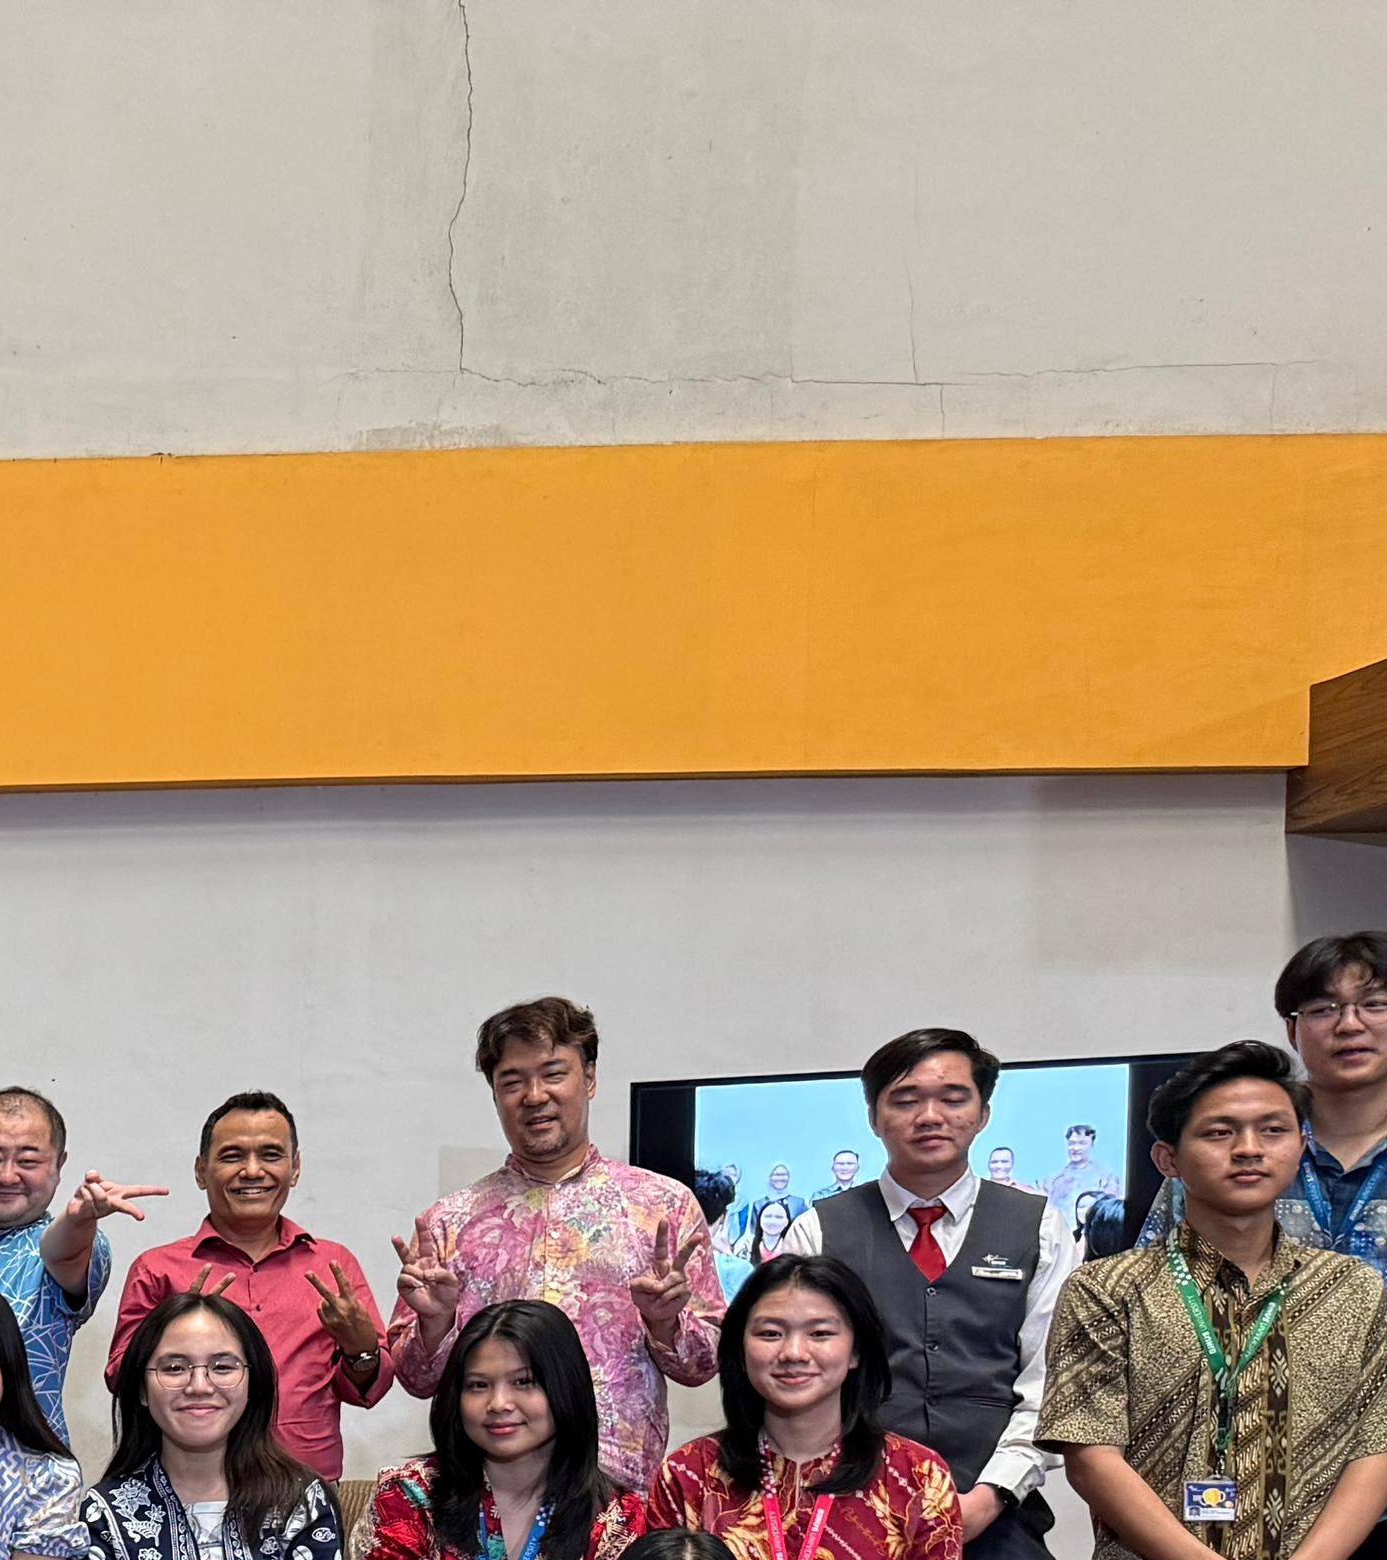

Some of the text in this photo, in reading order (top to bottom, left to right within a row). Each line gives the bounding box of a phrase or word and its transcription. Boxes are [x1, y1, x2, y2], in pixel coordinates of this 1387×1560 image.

[1185, 1293, 1217, 1354] BINUS UNIVERSITY
[811, 1507, 824, 1532] BINUS
